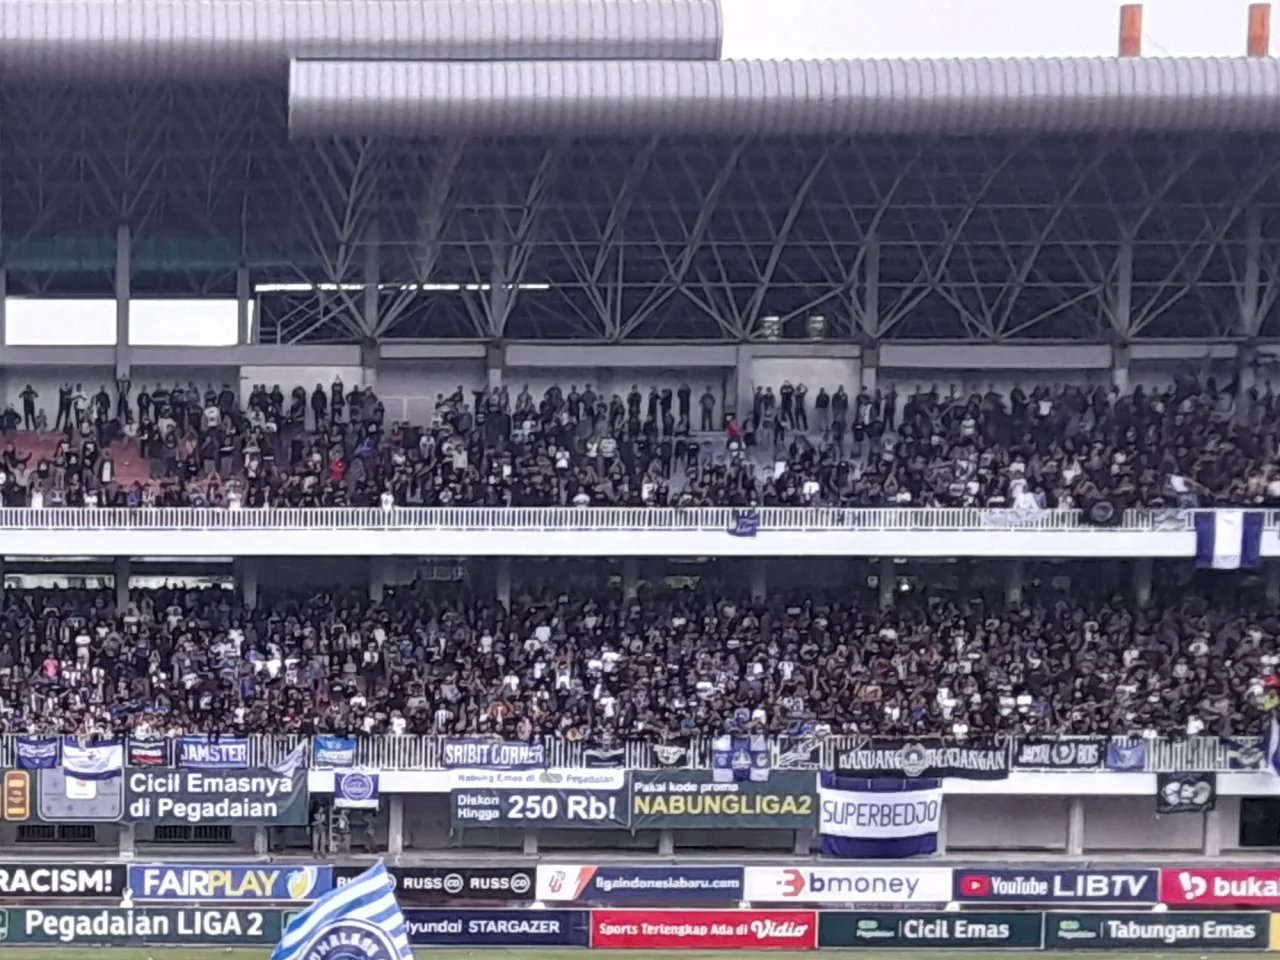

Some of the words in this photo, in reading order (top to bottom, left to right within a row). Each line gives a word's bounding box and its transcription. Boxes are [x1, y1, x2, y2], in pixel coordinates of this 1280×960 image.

[180, 744, 247, 763] JAMSTER
[491, 743, 545, 765] CORNER
[129, 773, 180, 793] Cicil
[187, 773, 293, 798] Emasnya
[634, 781, 666, 793] Pakai
[668, 781, 698, 793] kode
[129, 798, 150, 817] di
[158, 799, 278, 822] Pegadaian
[457, 794, 500, 806] Diskon
[507, 795, 558, 819] 250
[567, 795, 616, 820] Rb!
[457, 808, 500, 821] Hingga
[633, 794, 812, 815] NABUNGLIGA2
[822, 799, 938, 828] SUPERBEDJO
[143, 869, 280, 896] FAIRPLAY
[403, 877, 443, 889] RUSS
[470, 877, 510, 889] RUSS
[595, 877, 740, 891] ligaindonesiabaru.com
[809, 872, 920, 898] bmoney
[990, 875, 1049, 895] YouTube
[25, 909, 169, 941] Pegadaian
[178, 911, 242, 935] LIGA
[247, 911, 264, 935] 2
[468, 920, 560, 933] STARGAZER
[599, 923, 638, 937] Sports
[641, 923, 708, 938] Terlengkap
[710, 924, 733, 936] Ada
[735, 924, 748, 936] di
[750, 918, 808, 938] Vidio
[904, 919, 948, 939] Cicil
[954, 920, 1010, 939] Emas
[1107, 920, 1202, 944] Tabungan
[1203, 921, 1256, 939] Emas
